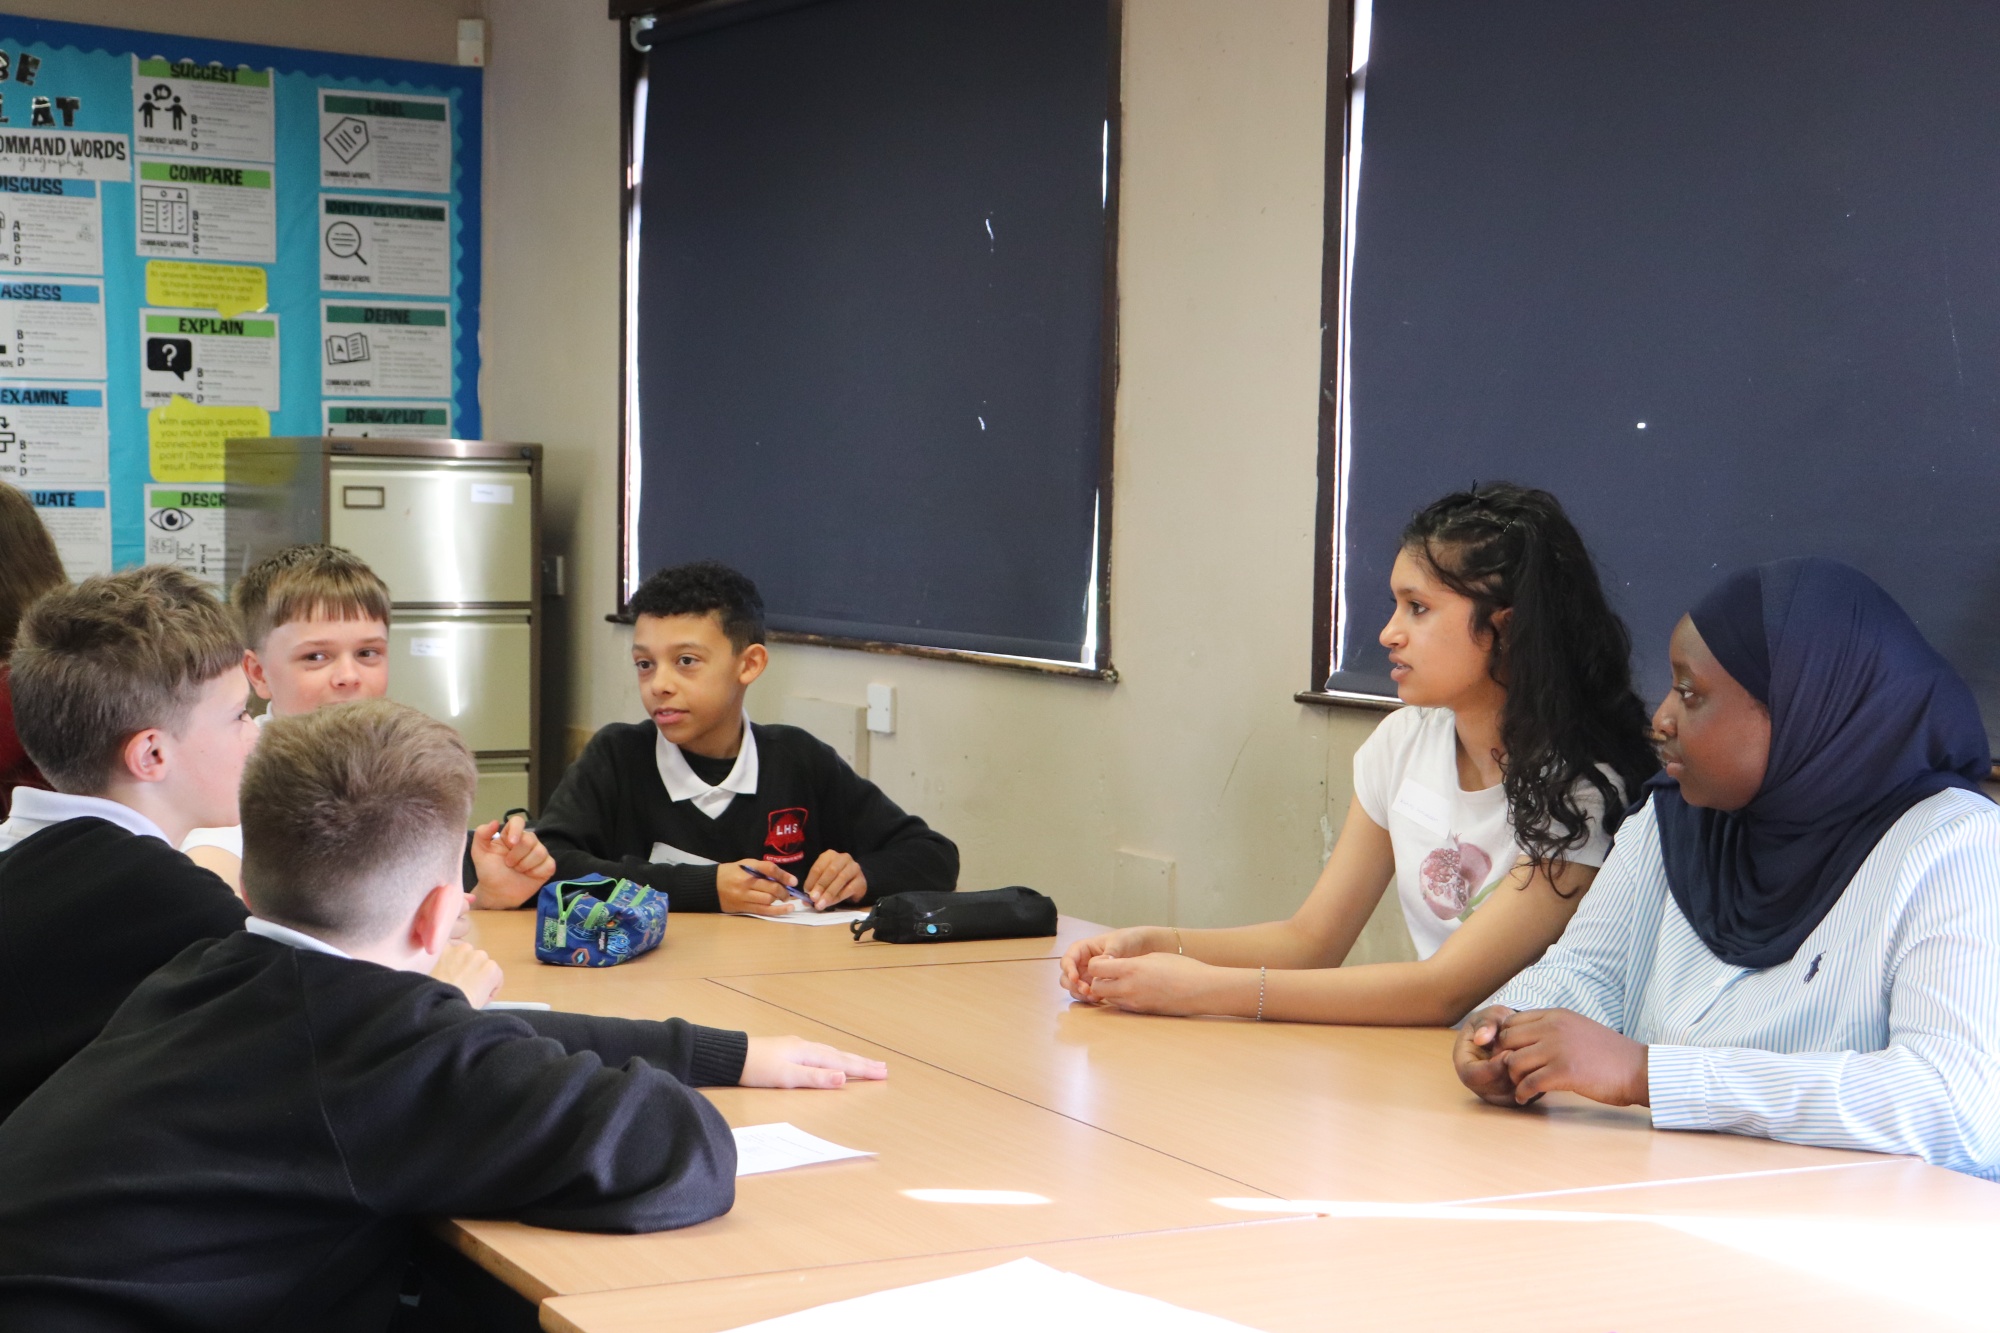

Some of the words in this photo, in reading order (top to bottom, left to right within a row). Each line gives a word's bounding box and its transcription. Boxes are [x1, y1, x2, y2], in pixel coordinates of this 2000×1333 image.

[170, 64, 239, 83] SUGGEST
[31, 96, 81, 127] AT
[71, 138, 126, 161] WORDS
[18, 152, 88, 175] geography
[169, 164, 243, 186] COMPARE
[0, 176, 63, 195] ISCUSS
[1, 284, 62, 302] ASSESS
[363, 307, 411, 324] DEFINE
[178, 317, 245, 335] EXPLAIN
[1, 388, 69, 405] EXAMINE
[345, 408, 427, 424] DRAW/PLOT
[776, 823, 799, 836] LHS
